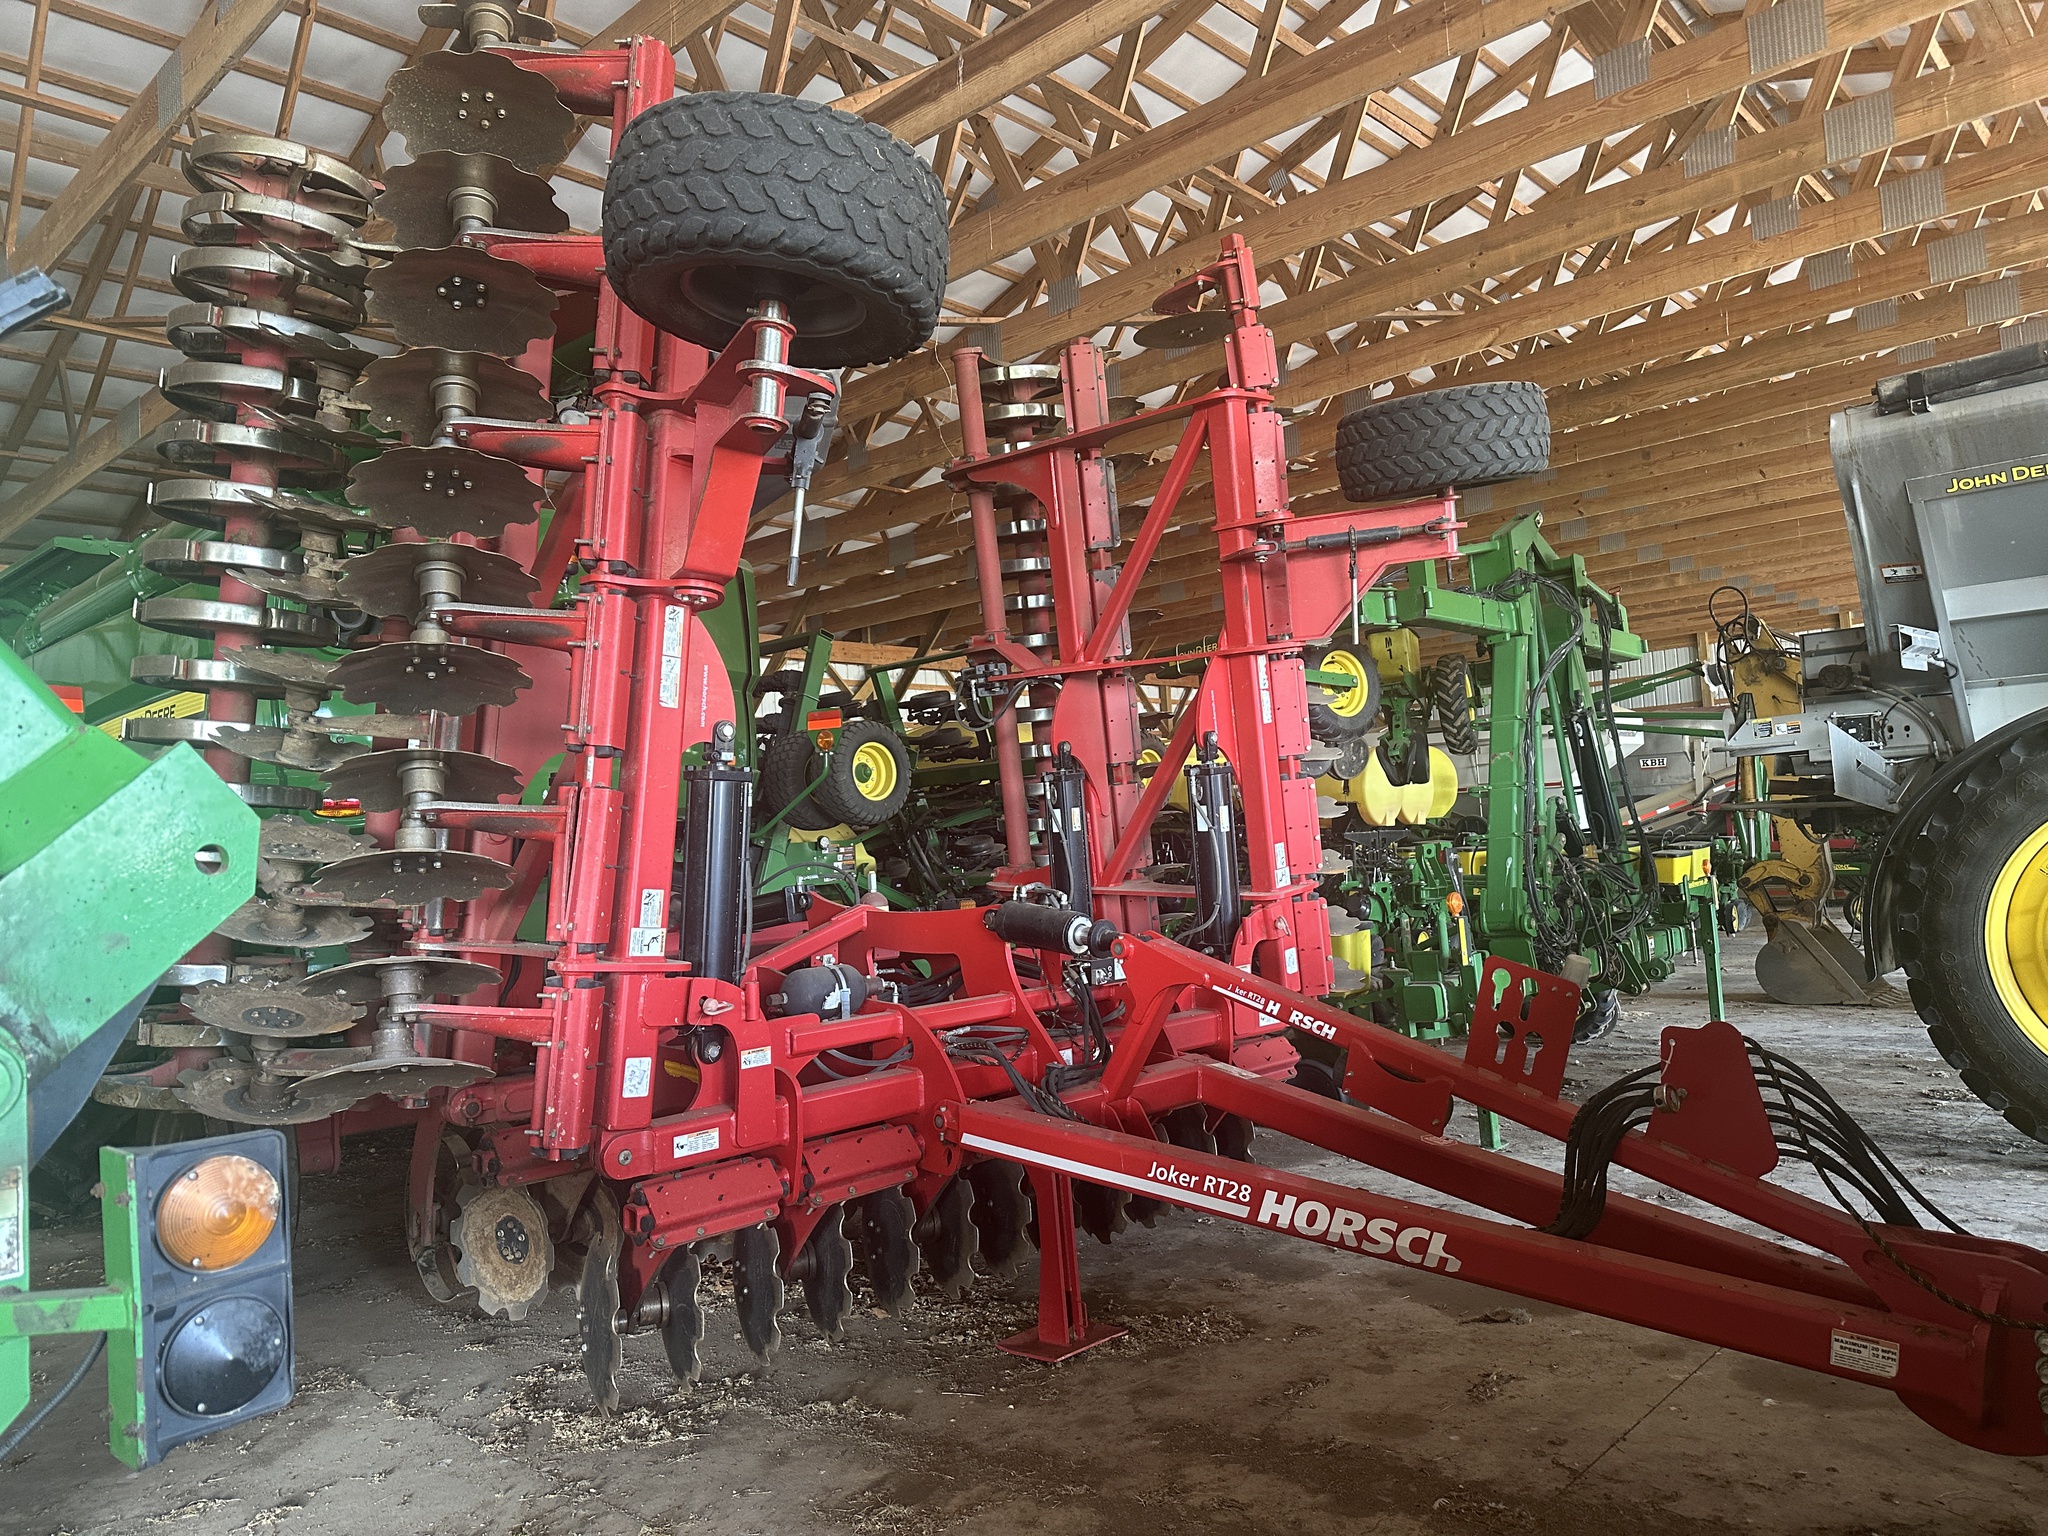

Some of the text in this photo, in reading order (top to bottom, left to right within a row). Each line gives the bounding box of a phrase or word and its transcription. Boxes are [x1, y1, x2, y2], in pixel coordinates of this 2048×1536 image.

[1946, 463, 2048, 493] JOHN DE
[700, 664, 709, 728] www.horsch.com
[1641, 758, 1666, 767] KBH
[1227, 983, 1247, 997] Jker
[1247, 991, 1266, 1005] RT28
[1265, 1000, 1338, 1040] HRSCH
[1147, 1161, 1199, 1189] Joker
[1203, 1174, 1252, 1202] RT28
[1834, 1337, 1868, 1350] MAXIMUM
[1839, 1345, 1862, 1355] SPEED
[1880, 1348, 1897, 1356] MPH
[1881, 1354, 1897, 1363] KPH
